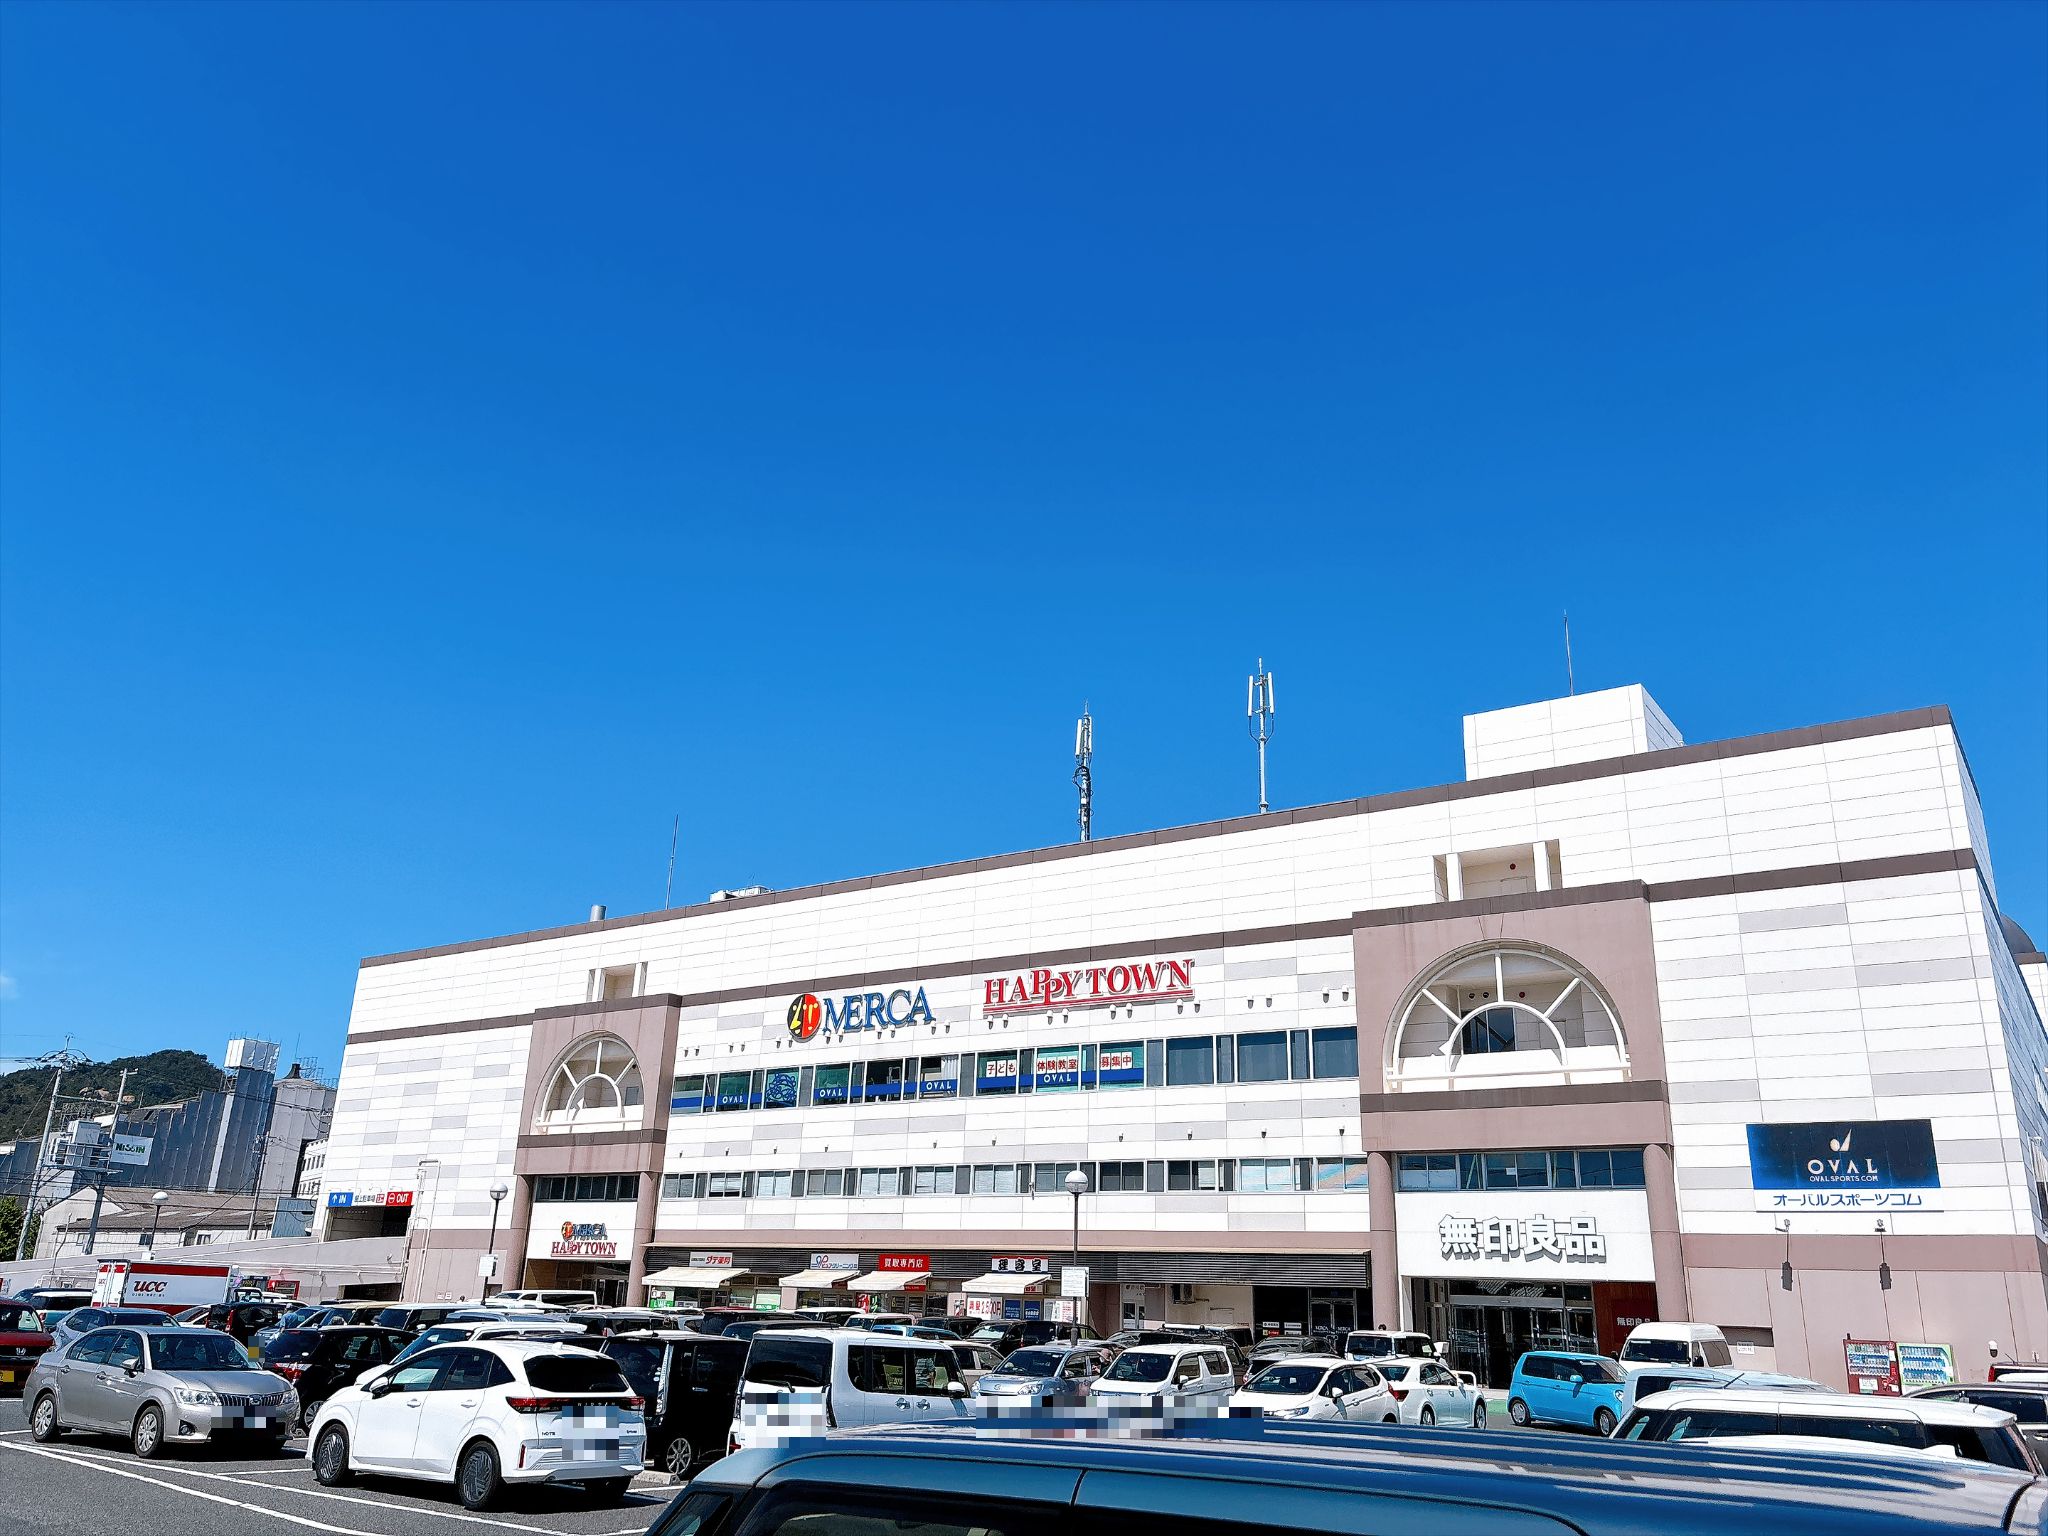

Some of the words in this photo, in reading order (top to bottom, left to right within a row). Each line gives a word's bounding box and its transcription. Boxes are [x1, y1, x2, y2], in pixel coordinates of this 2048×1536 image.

[822, 986, 936, 1036] MERCA
[986, 1061, 1017, 1076] 子ども
[1036, 1056, 1078, 1072] 体験教室
[1101, 1053, 1133, 1069] 募集中
[1043, 1072, 1072, 1083] OVAL
[926, 1081, 952, 1091] OVAL
[819, 1088, 843, 1098] OVAL
[722, 1094, 744, 1104] OVAL
[1807, 1158, 1878, 1175] OVAL
[338, 1194, 347, 1204] IN
[396, 1193, 410, 1203] OUT
[1773, 1193, 1922, 1207] オーバルスポーツコム
[1438, 1214, 1607, 1264] 無印良品
[884, 1258, 924, 1269] 買取専門店
[997, 1258, 1042, 1272] 理容室
